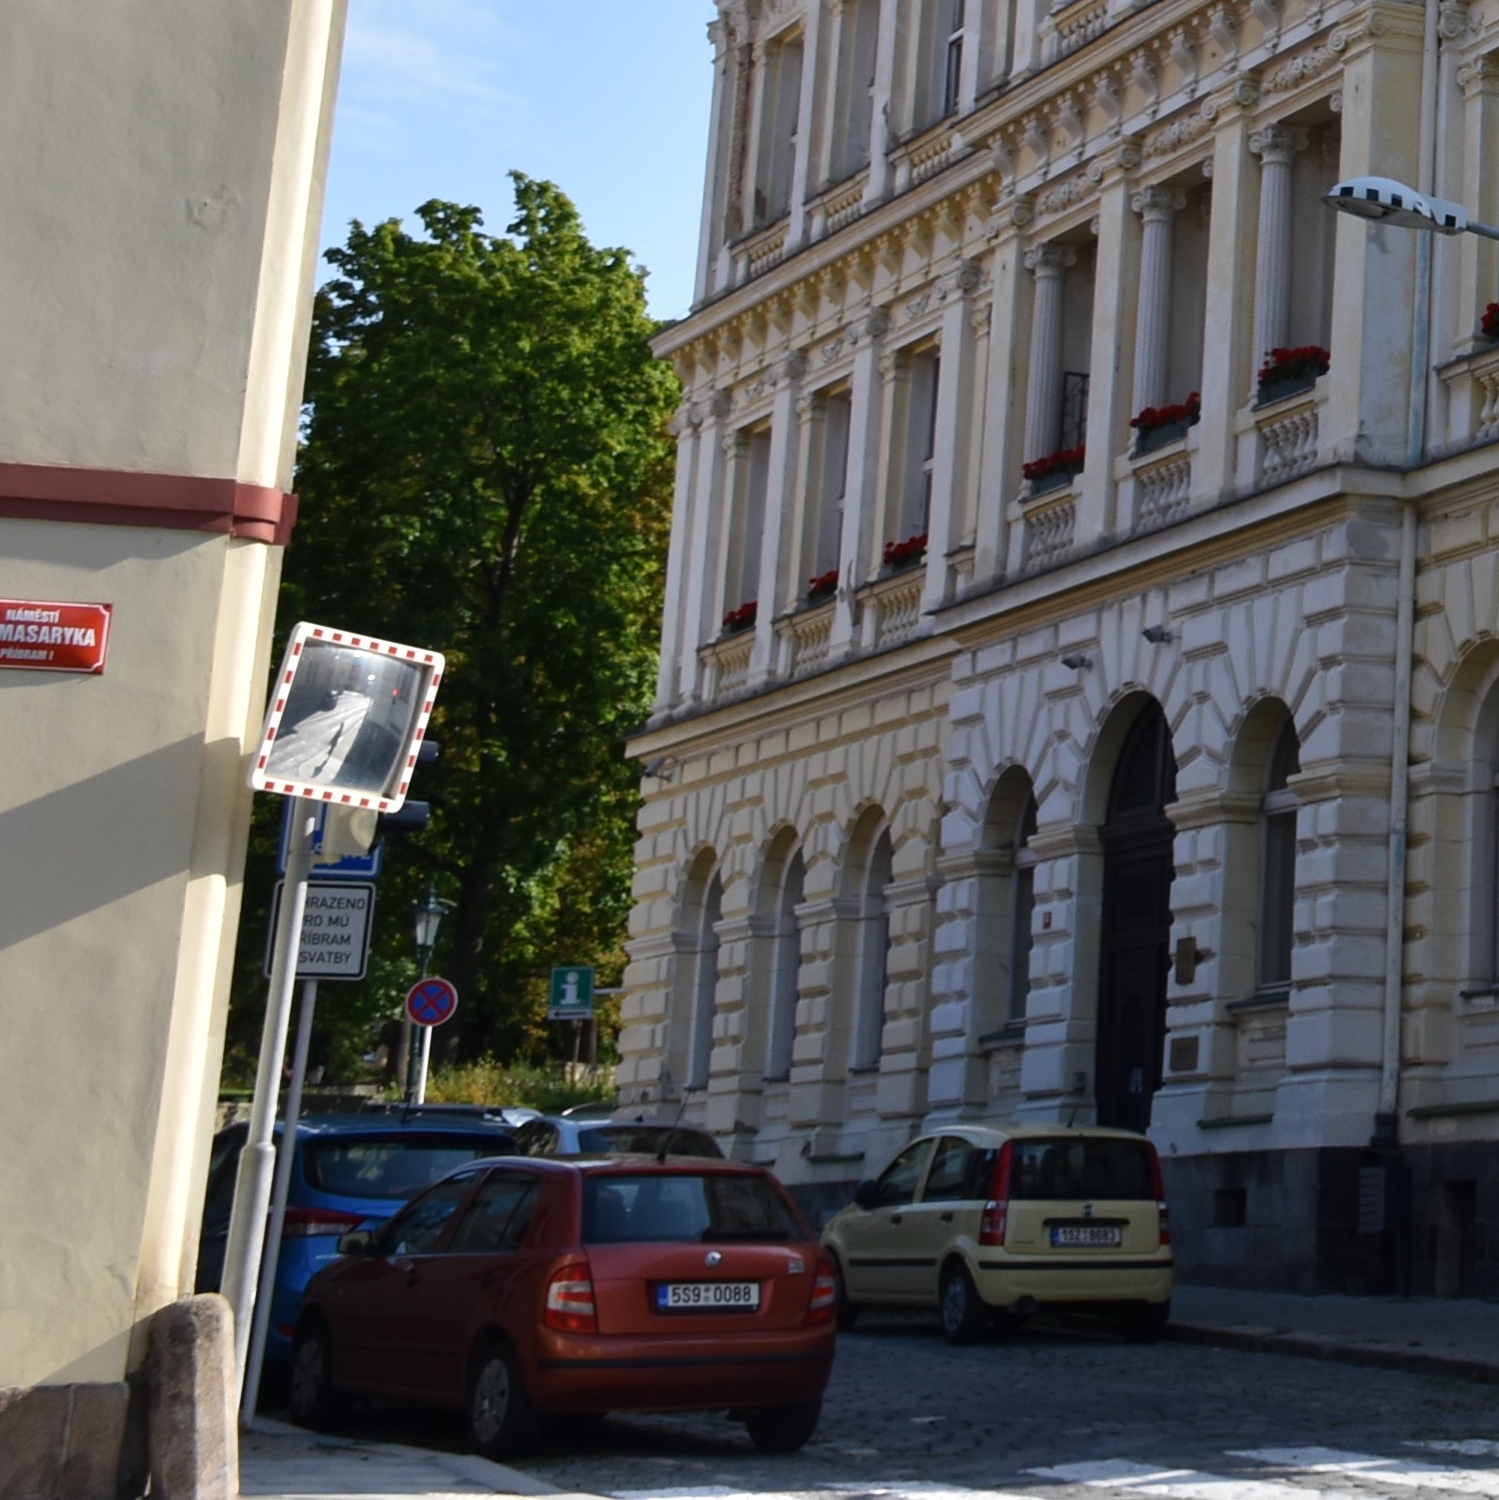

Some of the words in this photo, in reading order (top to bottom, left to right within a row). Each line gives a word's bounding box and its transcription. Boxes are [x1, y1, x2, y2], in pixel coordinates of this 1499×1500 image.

[6, 607, 61, 623] NÁMĚSTÍ
[306, 896, 366, 910] RAZENO
[303, 914, 323, 927] RO
[299, 951, 352, 964] SVATBY
[672, 1286, 701, 1303] 5S9
[713, 1285, 752, 1303] 0088
